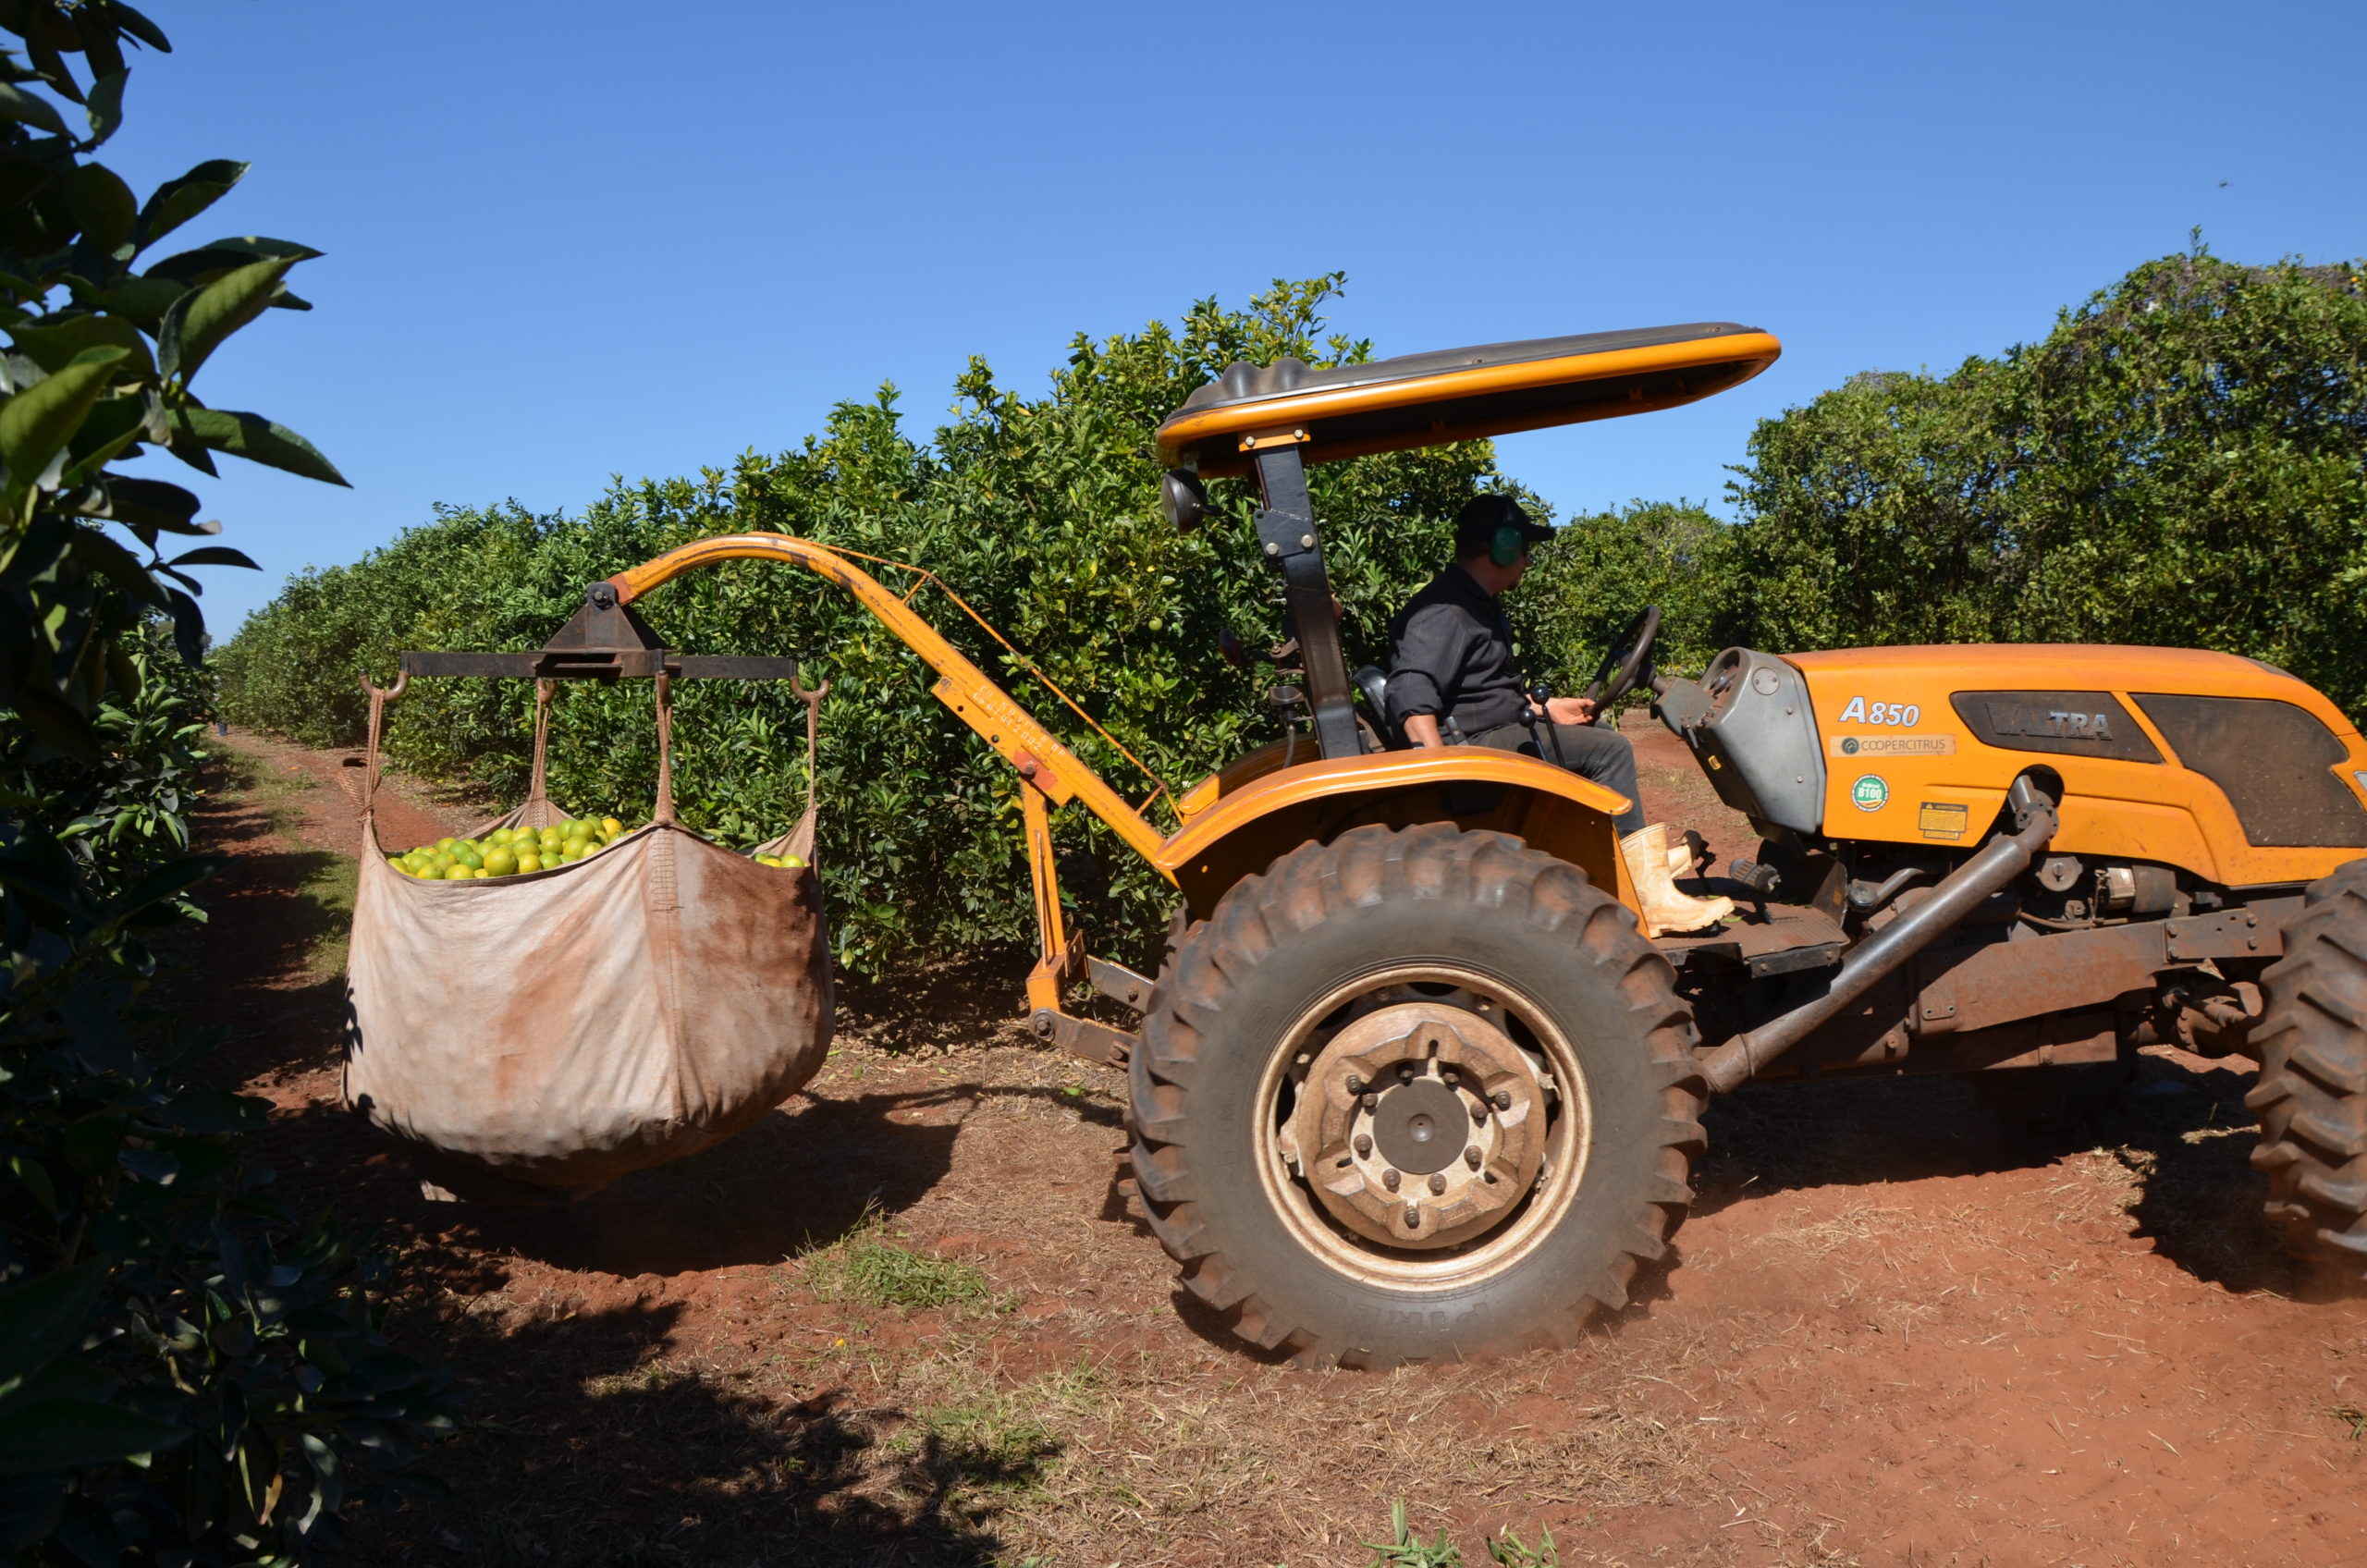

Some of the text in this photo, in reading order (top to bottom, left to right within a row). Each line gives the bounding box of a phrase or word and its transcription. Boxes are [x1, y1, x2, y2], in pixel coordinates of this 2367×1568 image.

[1837, 695, 1920, 728] A850
[1861, 739, 1946, 752] COOPERCITRUS
[1858, 787, 1883, 799] B100
